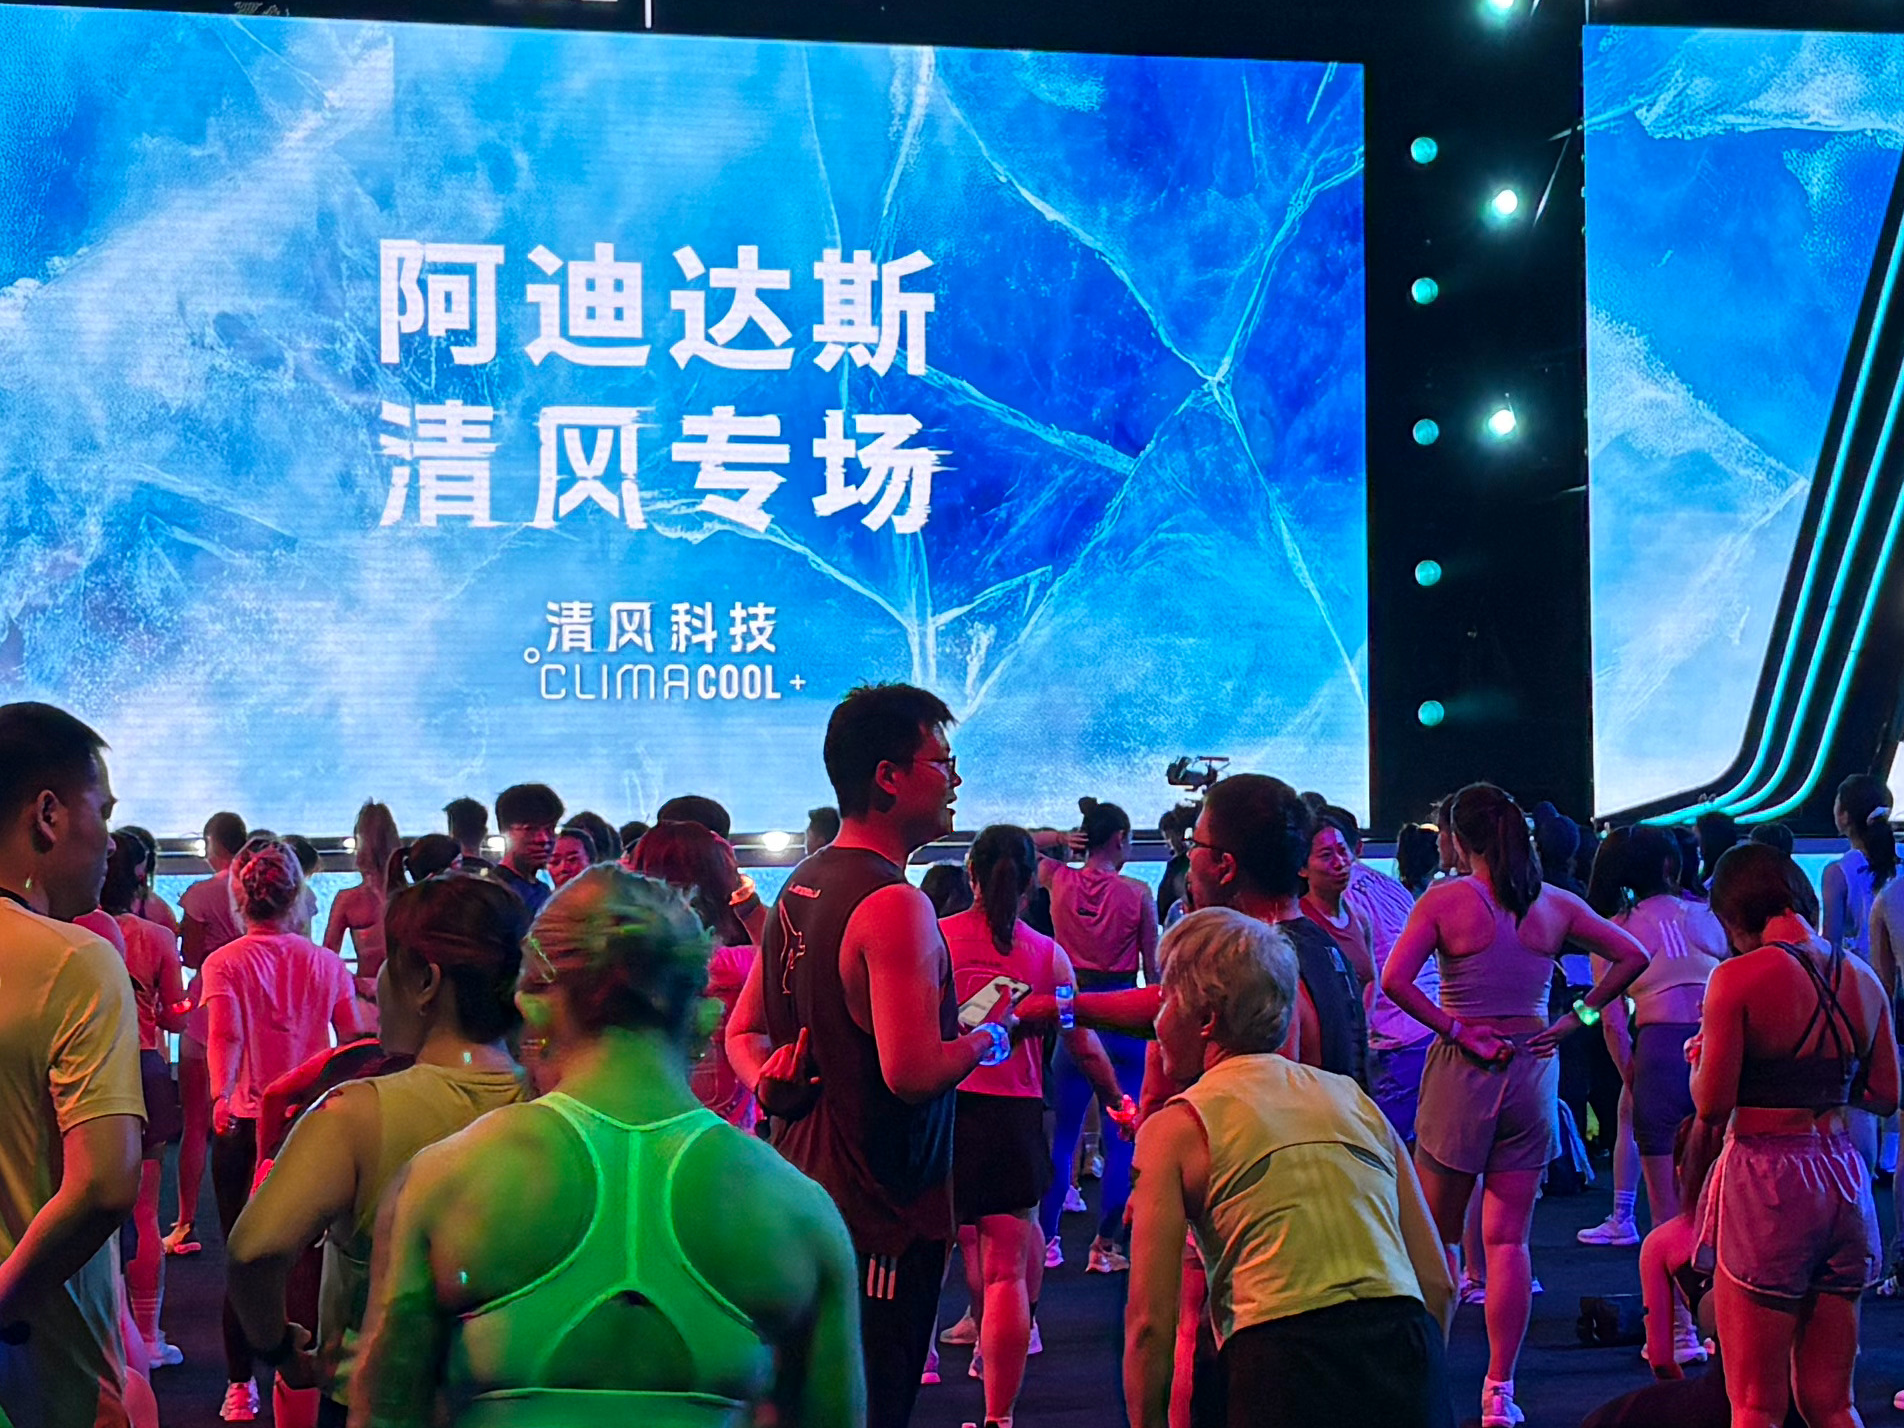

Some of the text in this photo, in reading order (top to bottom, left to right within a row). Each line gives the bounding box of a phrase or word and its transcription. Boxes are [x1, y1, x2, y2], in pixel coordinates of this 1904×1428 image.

[380, 239, 936, 376] 阿迪达斯
[379, 401, 948, 536] 清风专场
[546, 601, 778, 654] 清风科技
